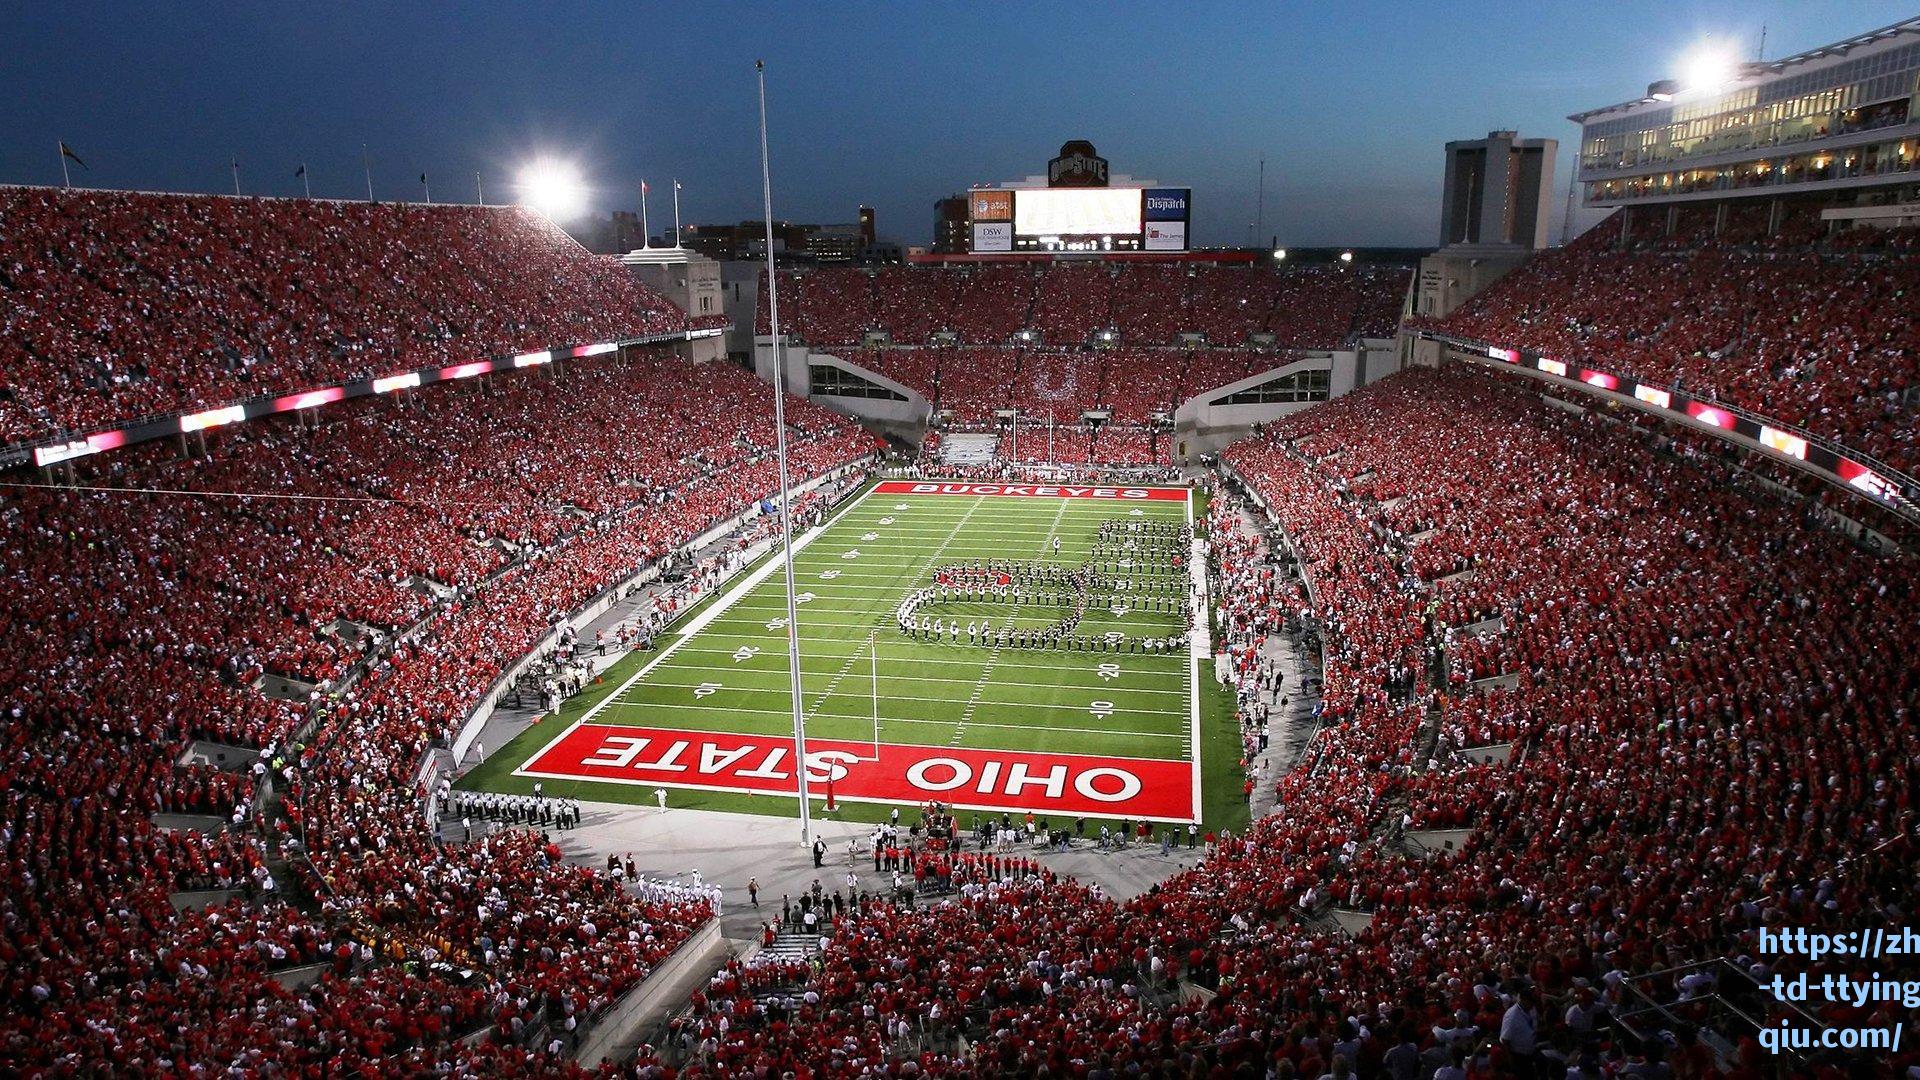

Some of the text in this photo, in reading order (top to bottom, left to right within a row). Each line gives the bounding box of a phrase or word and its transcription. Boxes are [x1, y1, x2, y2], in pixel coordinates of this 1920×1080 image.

[1147, 197, 1185, 210] Dispatch
[983, 228, 1002, 236] DSW
[911, 484, 1149, 498] BUCKEYES
[1097, 663, 1120, 678] 20
[1089, 701, 1114, 715] 10
[580, 736, 1143, 802] OHIO STATE
